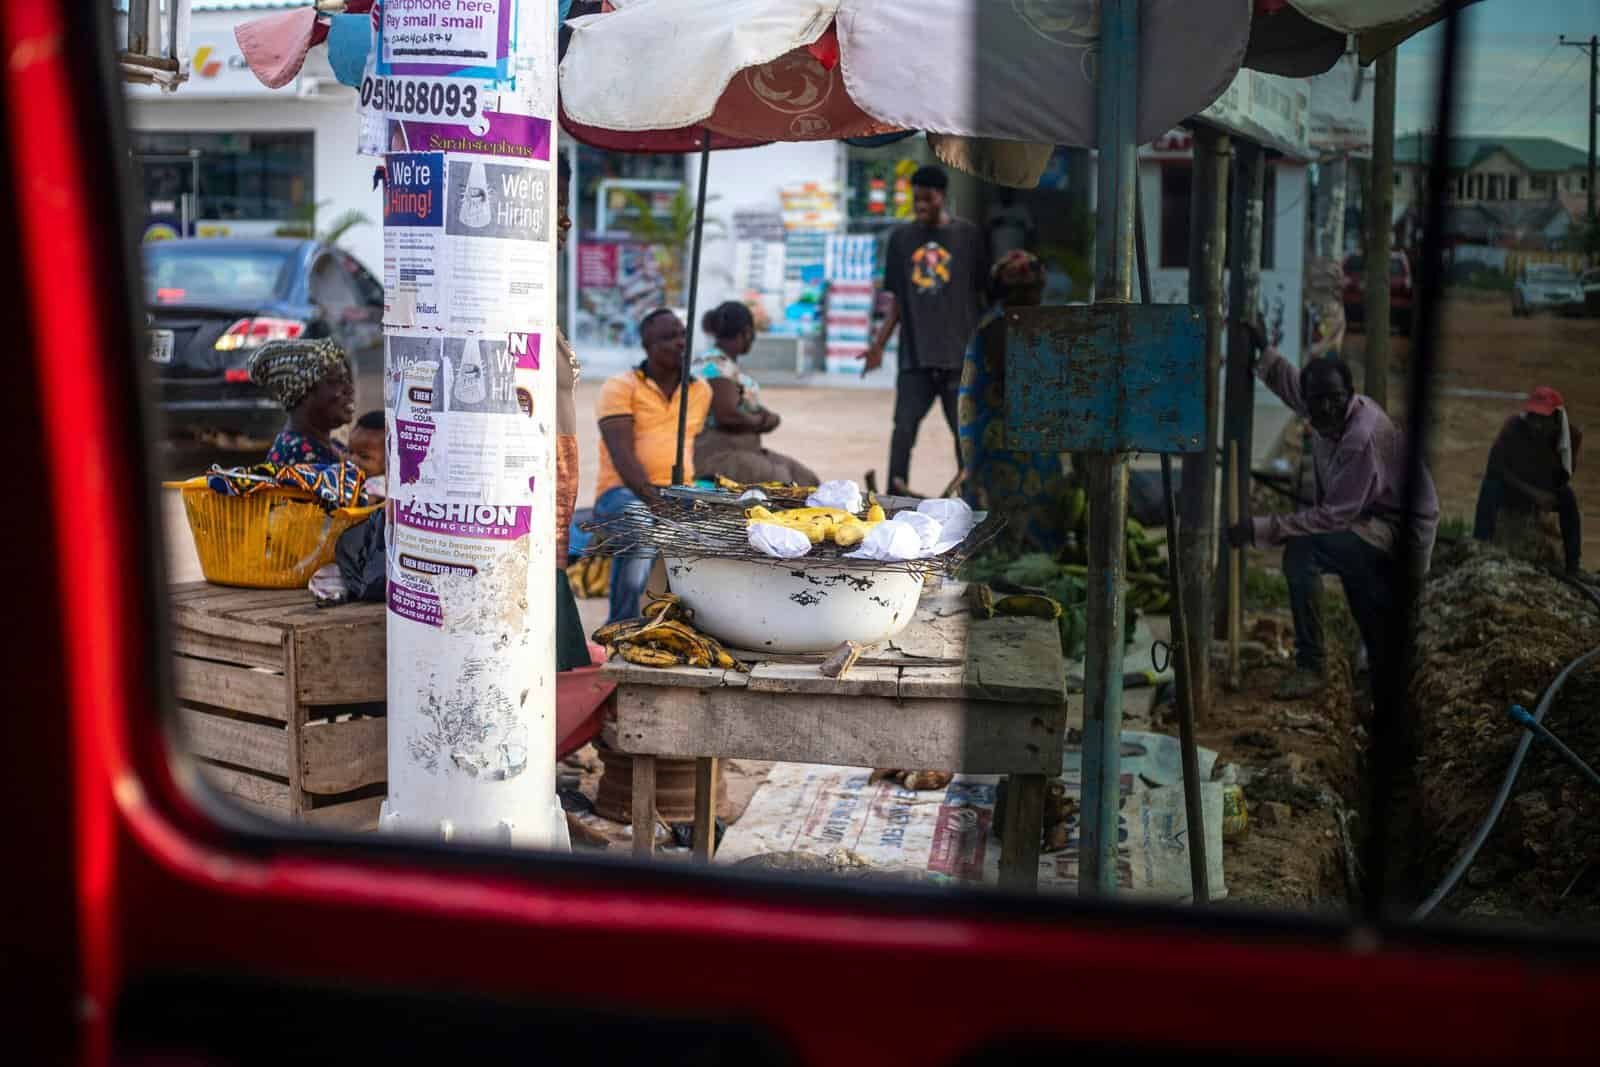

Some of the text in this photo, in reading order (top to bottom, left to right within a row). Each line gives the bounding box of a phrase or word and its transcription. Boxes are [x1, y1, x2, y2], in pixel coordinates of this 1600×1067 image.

[456, 0, 496, 14] here,
[386, 13, 483, 29] Pay small small
[360, 77, 477, 118] 059188093
[392, 160, 431, 185] We're
[502, 173, 545, 202] We're
[391, 190, 432, 219] Hiring!
[497, 201, 545, 233] Hiring!
[400, 501, 517, 527] FASHION
[404, 515, 508, 536] TRAINING CENTER
